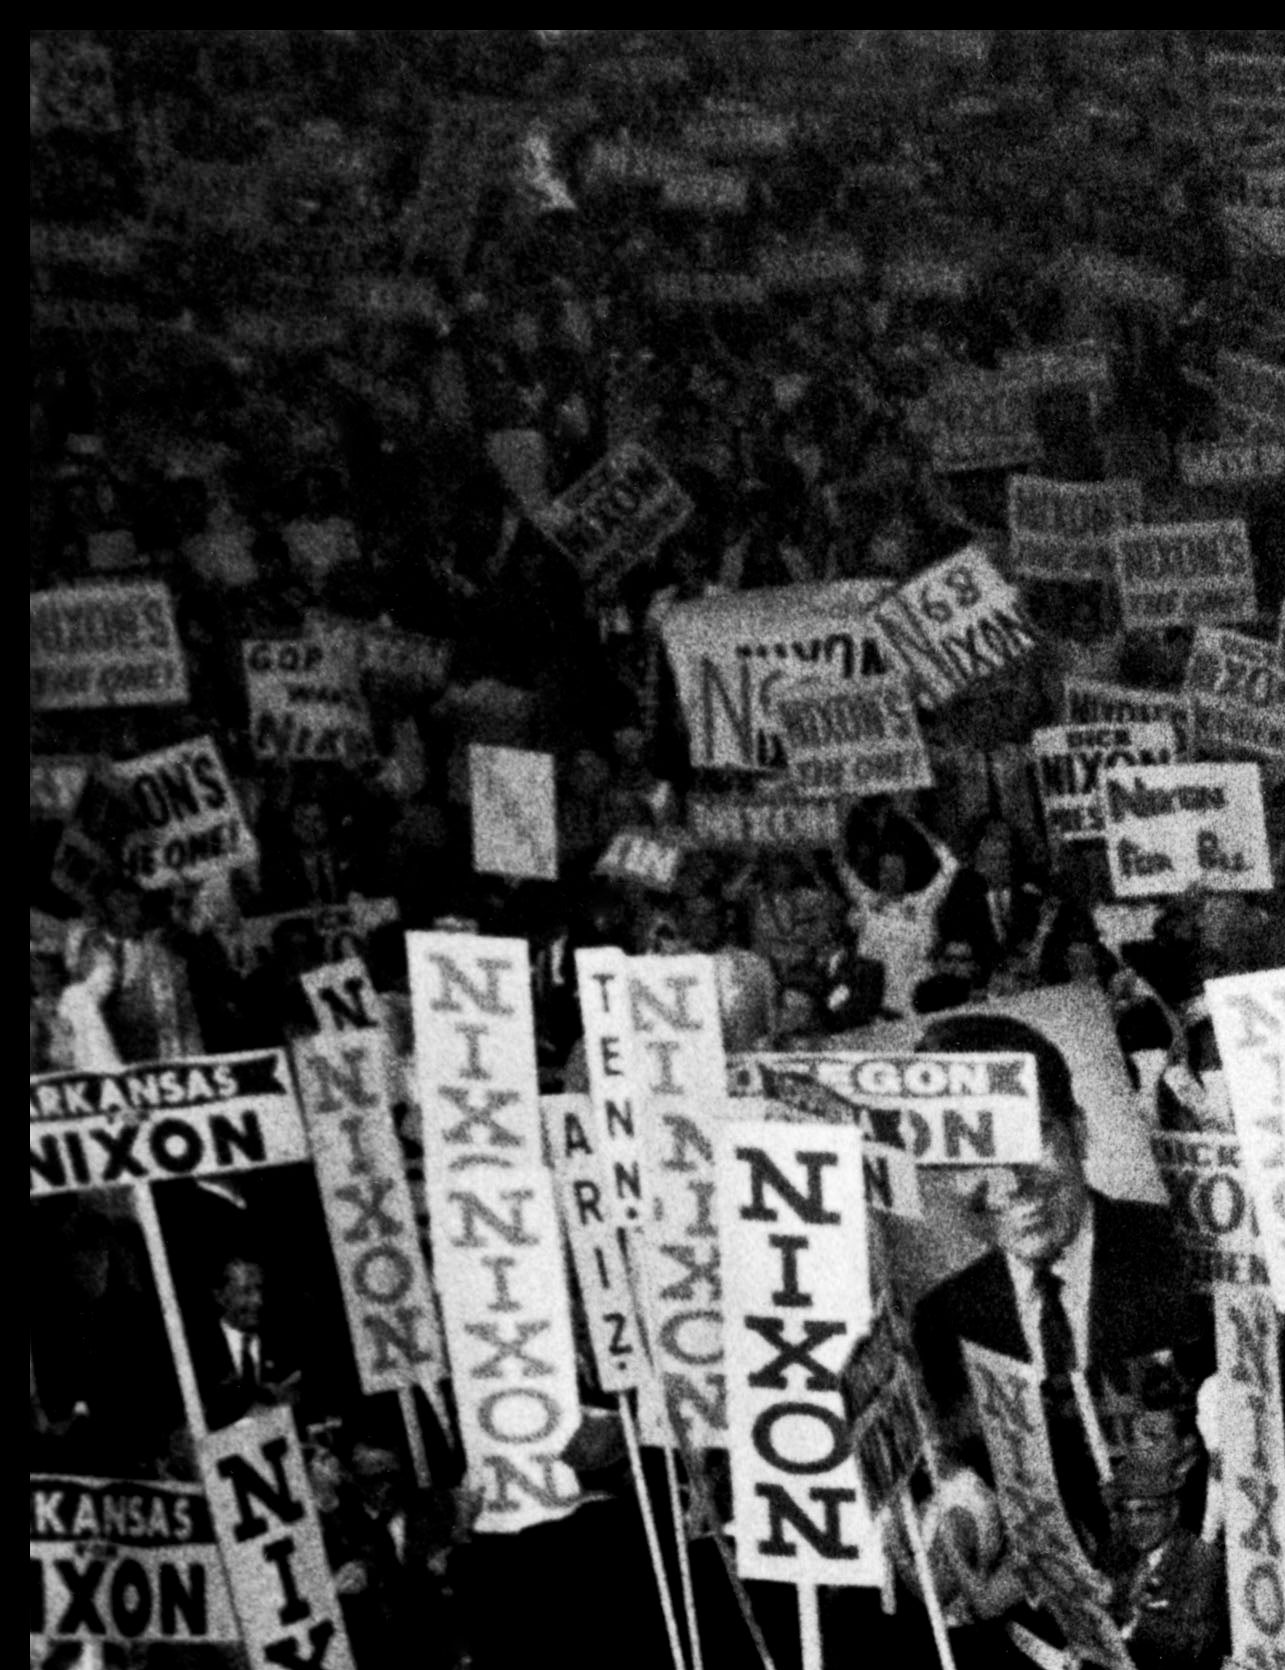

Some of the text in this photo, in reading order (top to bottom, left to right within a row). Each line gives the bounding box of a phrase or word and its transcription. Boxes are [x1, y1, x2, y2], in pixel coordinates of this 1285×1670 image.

[134, 752, 226, 828] ON'S
[305, 1045, 434, 1376] NIXON
[449, 1185, 582, 1516] NIXON
[734, 1145, 859, 1561] NIXON
